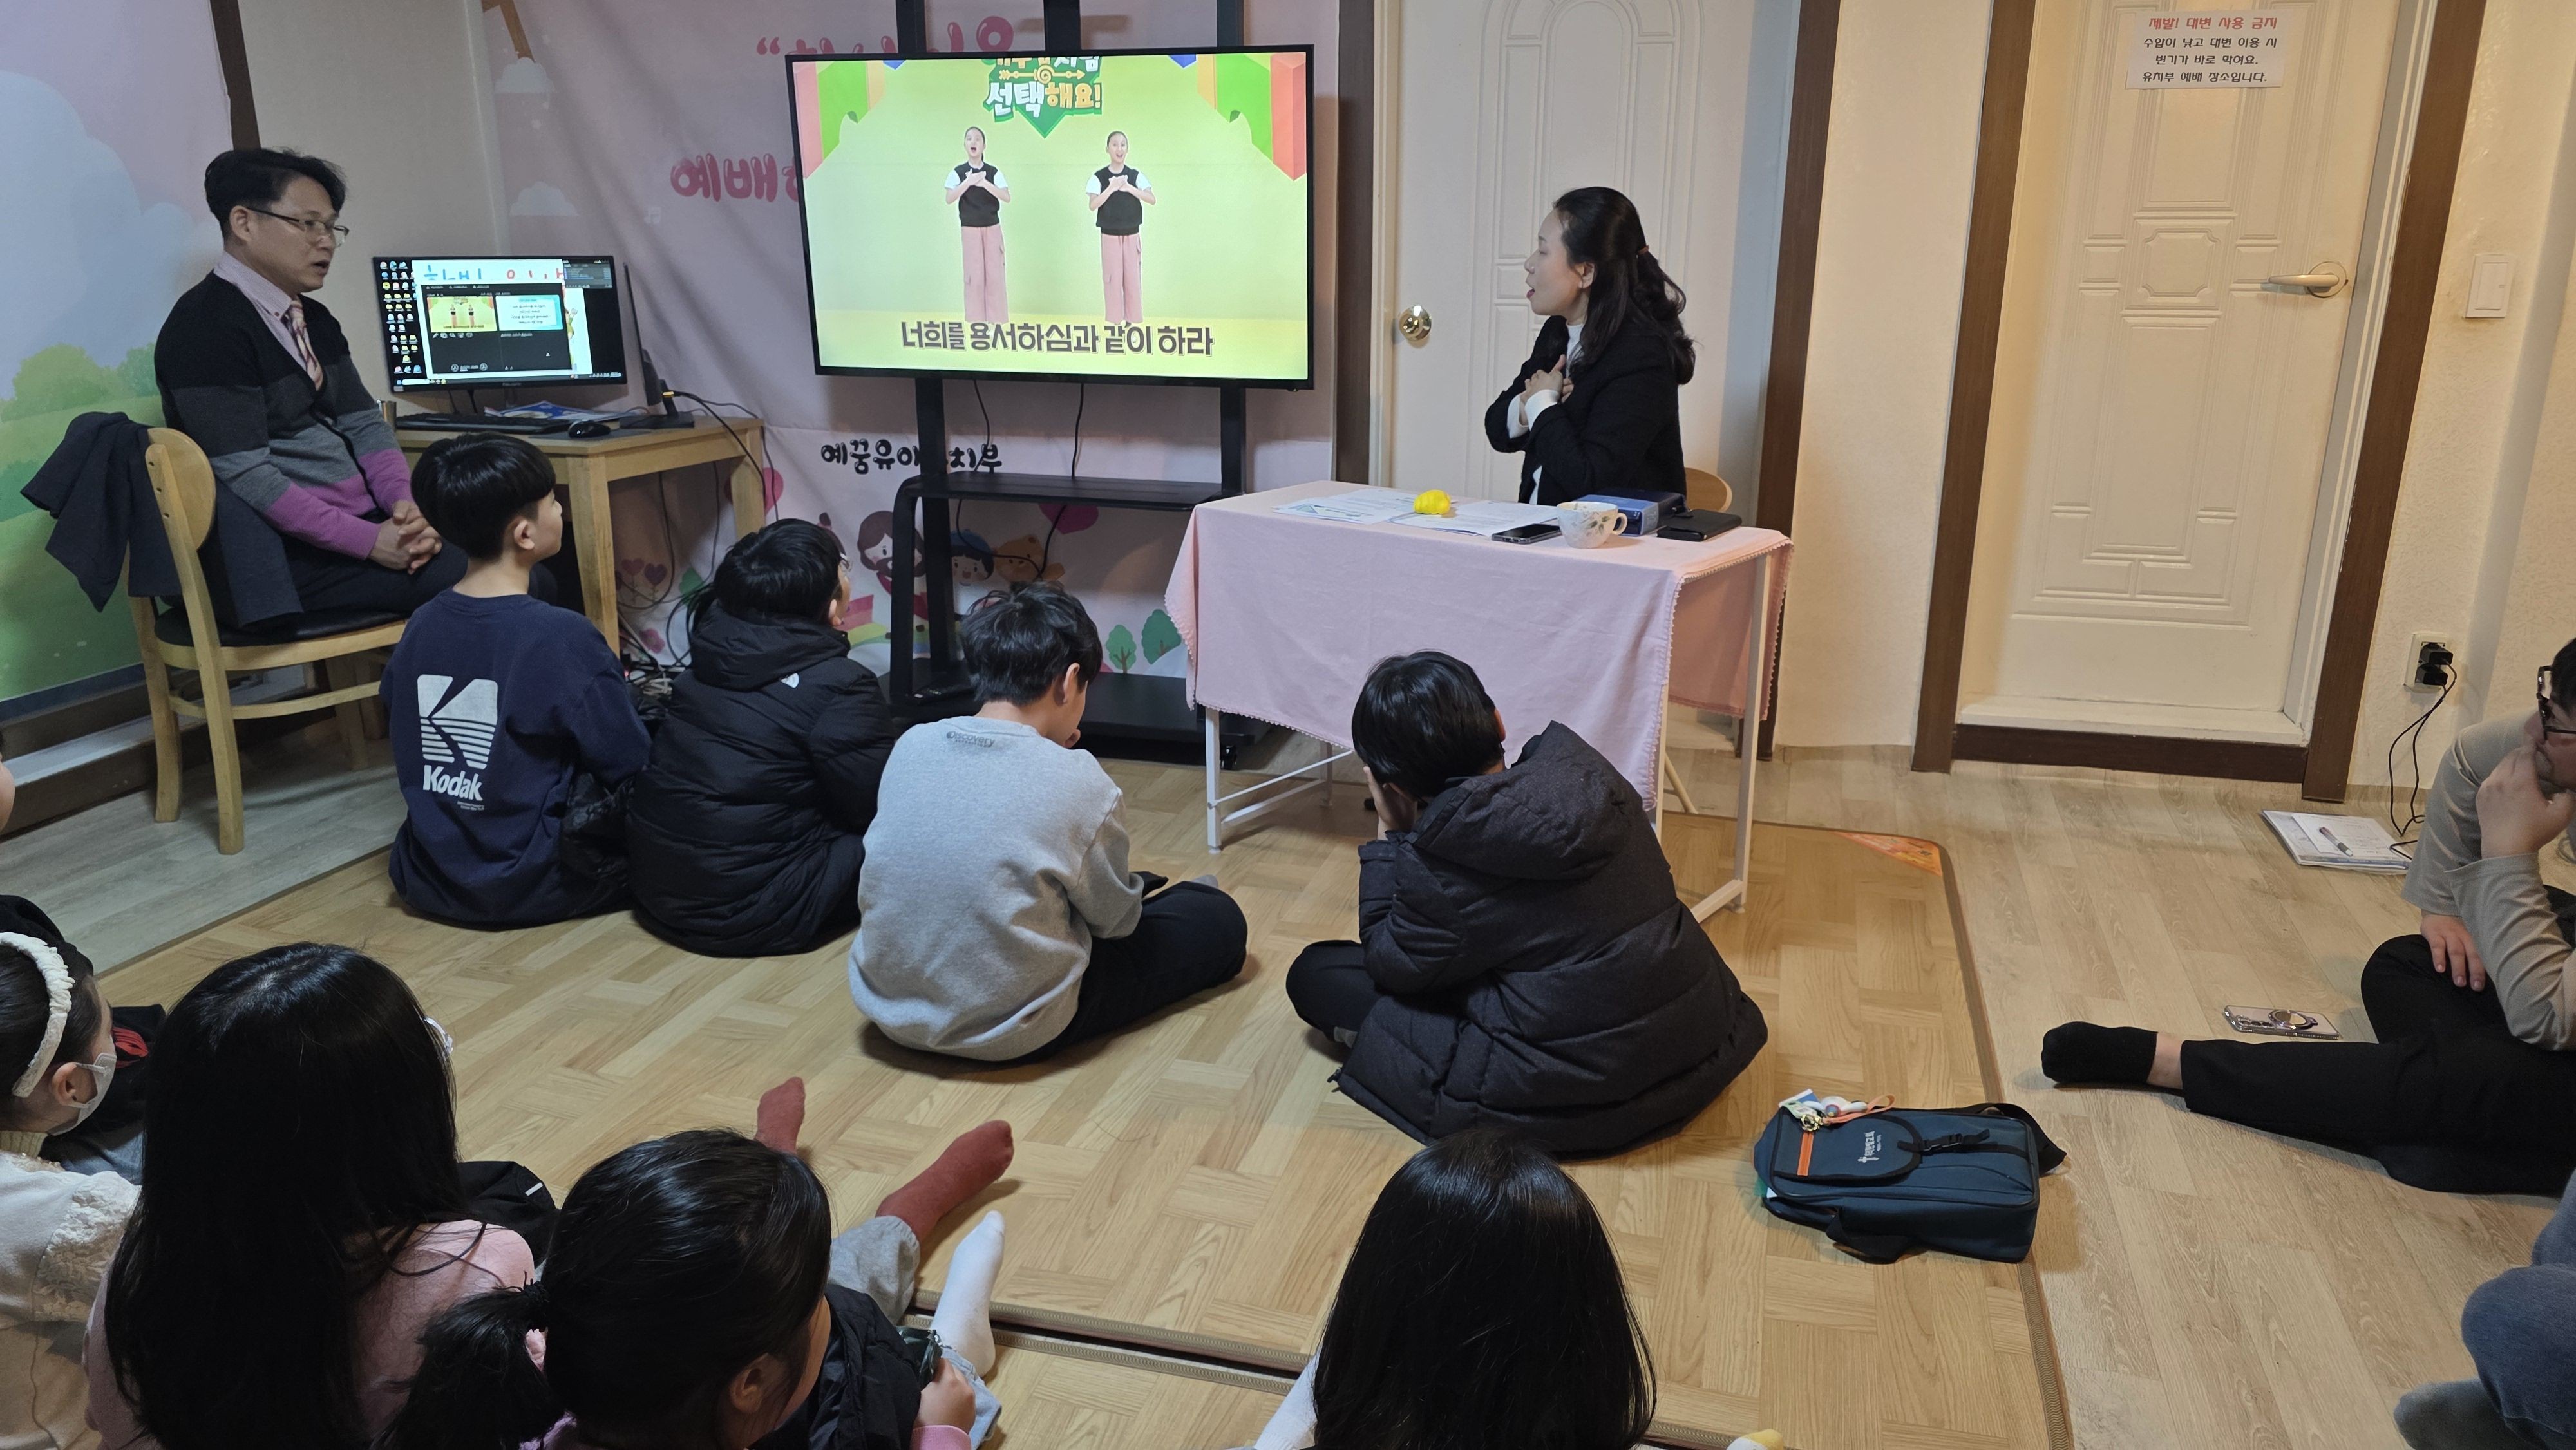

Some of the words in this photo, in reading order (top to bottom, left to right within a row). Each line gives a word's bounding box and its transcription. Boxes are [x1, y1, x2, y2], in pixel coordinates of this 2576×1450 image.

[2149, 17, 2179, 30] 제발!
[2186, 17, 2211, 30] 대변
[2218, 17, 2244, 30] 사용
[2251, 17, 2277, 30] 금지
[2143, 37, 2176, 48] 수압이
[2183, 37, 2204, 48] 낮고
[2210, 37, 2232, 48] 대변
[2238, 37, 2260, 48] 이용
[2266, 37, 2278, 48] 시
[2155, 55, 2189, 66] 변기가
[2194, 55, 2216, 65] 바로
[2142, 71, 2175, 82] 유치부
[2181, 71, 2203, 82] 예배
[2208, 71, 2268, 82] 장소입니다.
[985, 81, 1101, 118] 선택해요!
[901, 321, 966, 351] 너희를
[969, 322, 1099, 353] 용서하심과
[1104, 325, 1152, 355] 같이
[1157, 326, 1213, 356] 하라
[422, 764, 484, 801] Kodak
